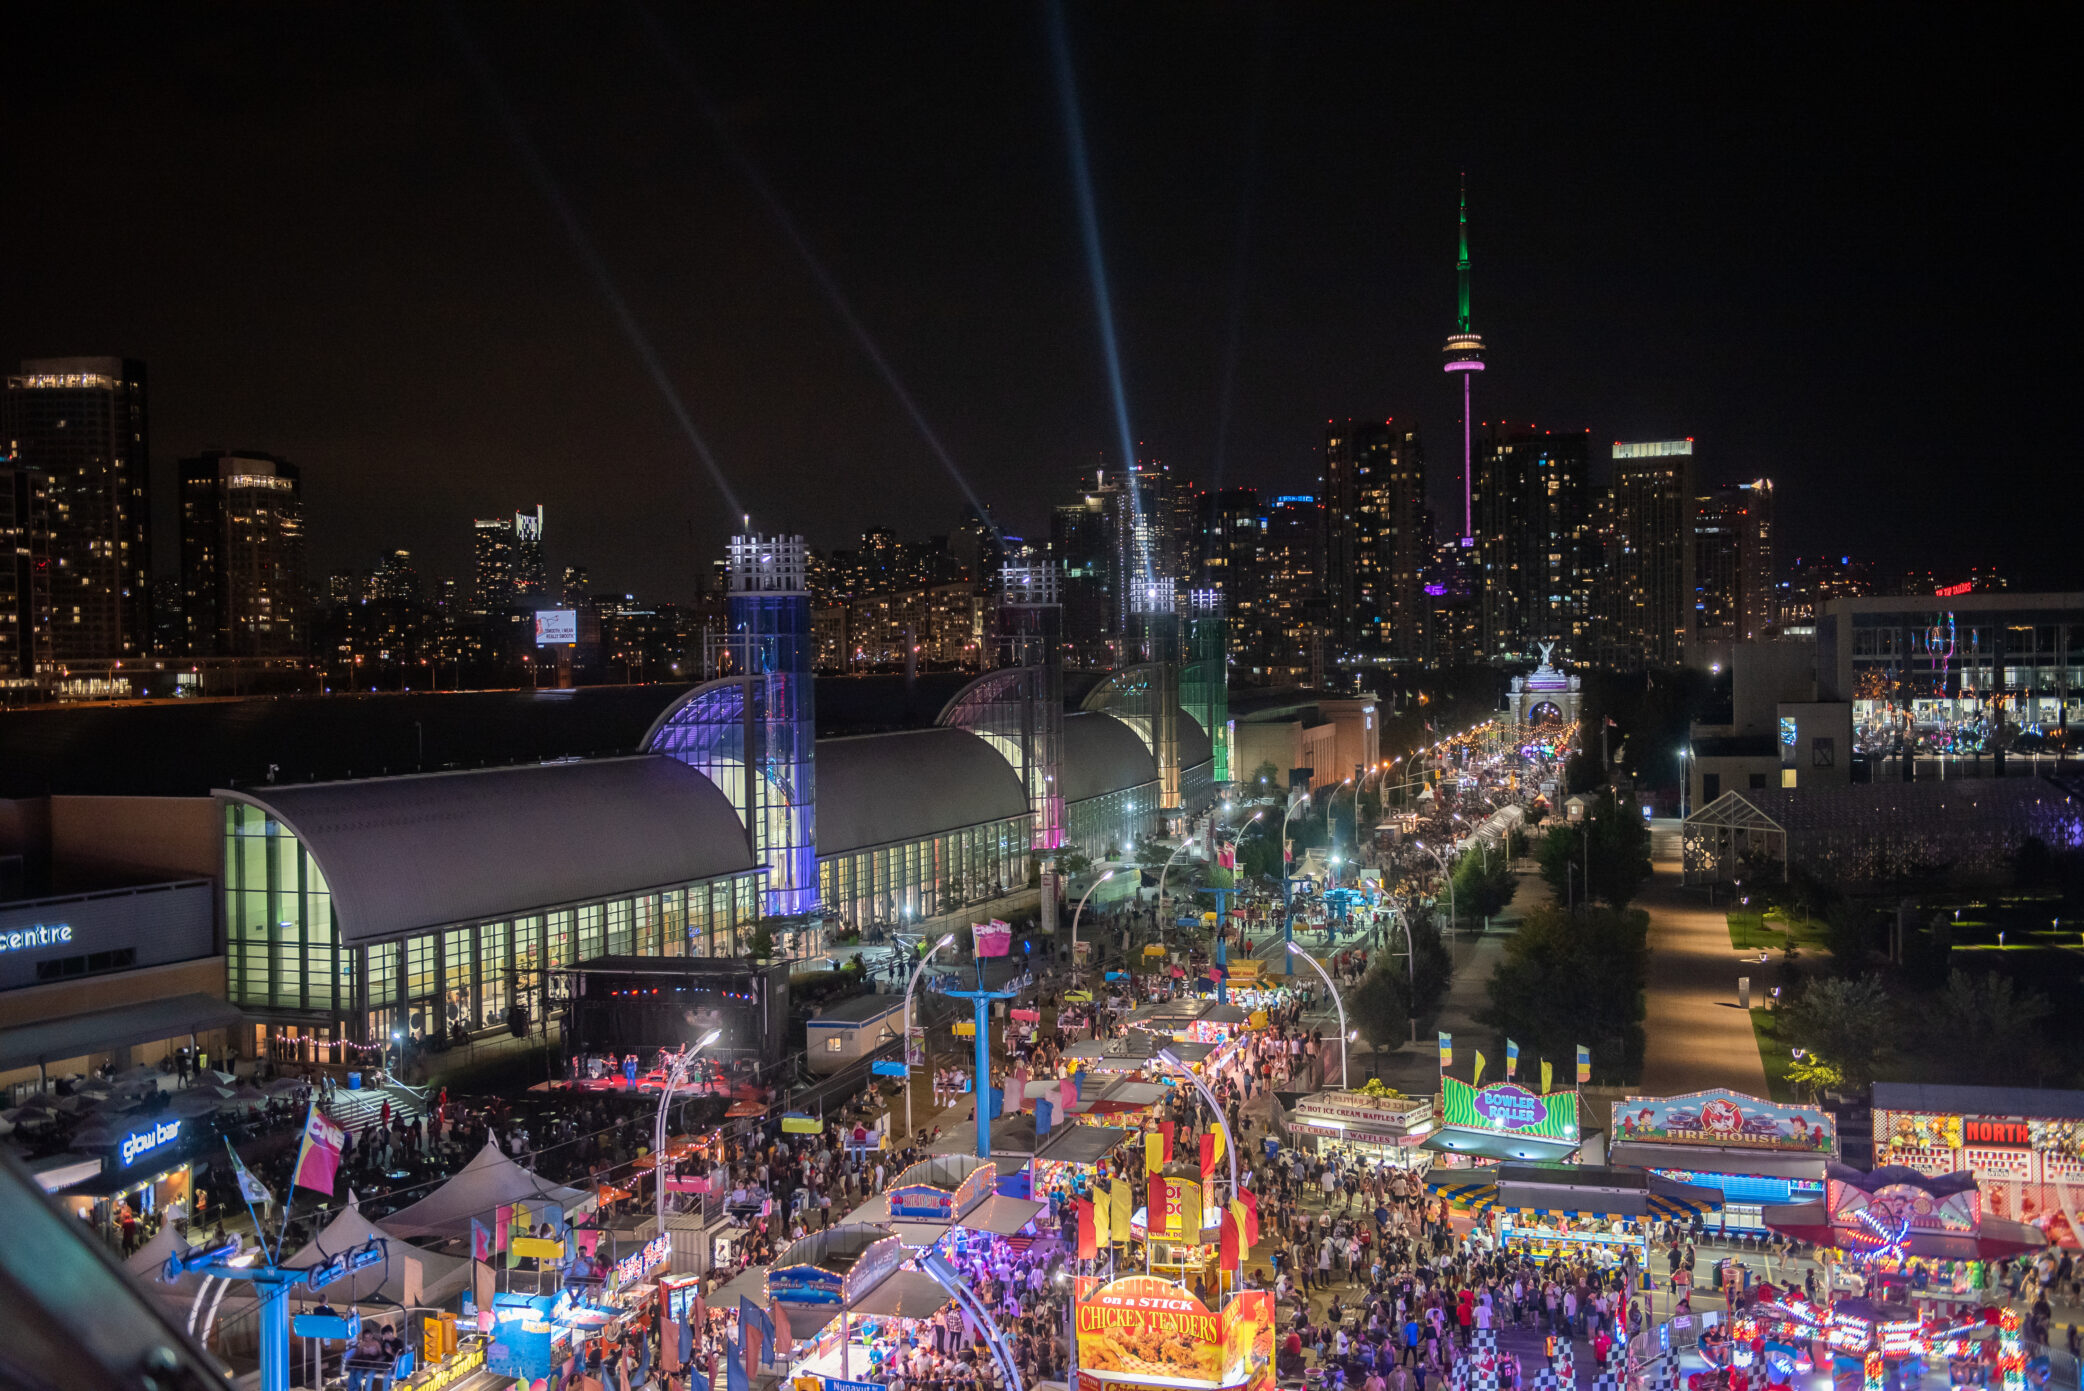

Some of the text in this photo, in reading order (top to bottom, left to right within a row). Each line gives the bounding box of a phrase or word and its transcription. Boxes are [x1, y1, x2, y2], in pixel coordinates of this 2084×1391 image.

[0, 926, 72, 951] centre
[1485, 1093, 1536, 1110] BOWLER
[1307, 1105, 1396, 1123] HOT ICE CREAM WAFFLES
[1489, 1105, 1535, 1122] ROLLER
[311, 1116, 345, 1148] CNE
[1291, 1124, 1336, 1136] ICE CREAM
[1350, 1132, 1391, 1143] WAFFLES
[1666, 1128, 1783, 1144] FIRE HOUSE
[1966, 1121, 2029, 1143] NORTH
[122, 1119, 181, 1167] glow bar
[1893, 1156, 1950, 1165] SHOTS
[1968, 1150, 2027, 1160] HOOP
[1968, 1159, 2028, 1169] SHOTS
[2047, 1164, 2084, 1172] SHO
[1112, 1280, 1185, 1299] CHICKEN
[1102, 1296, 1121, 1305] on
[1138, 1297, 1194, 1311] STICK
[1080, 1305, 1146, 1332] CHICKEN
[1148, 1311, 1218, 1345] TENDERS
